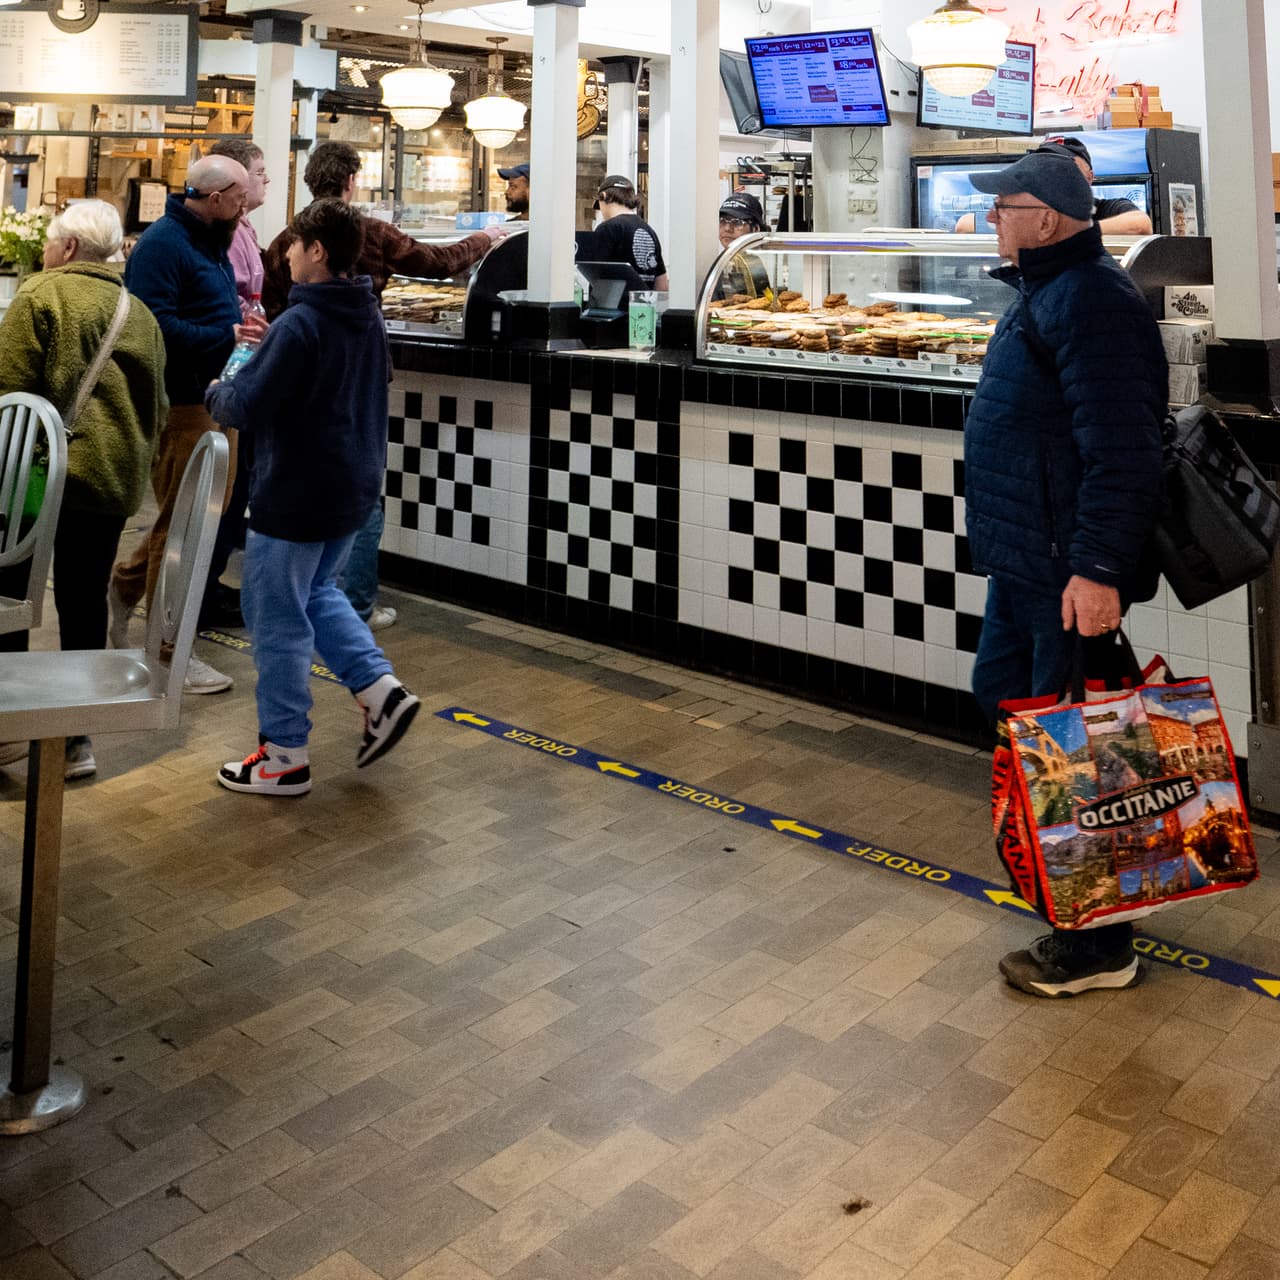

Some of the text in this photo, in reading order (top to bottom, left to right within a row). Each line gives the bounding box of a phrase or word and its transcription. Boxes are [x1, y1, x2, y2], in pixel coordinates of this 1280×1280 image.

[503, 728, 579, 757] ORDER
[657, 779, 746, 815] ORDER
[1081, 780, 1196, 827] OCCITANIE
[845, 841, 951, 882] ORDER
[1132, 937, 1211, 971] ORD
